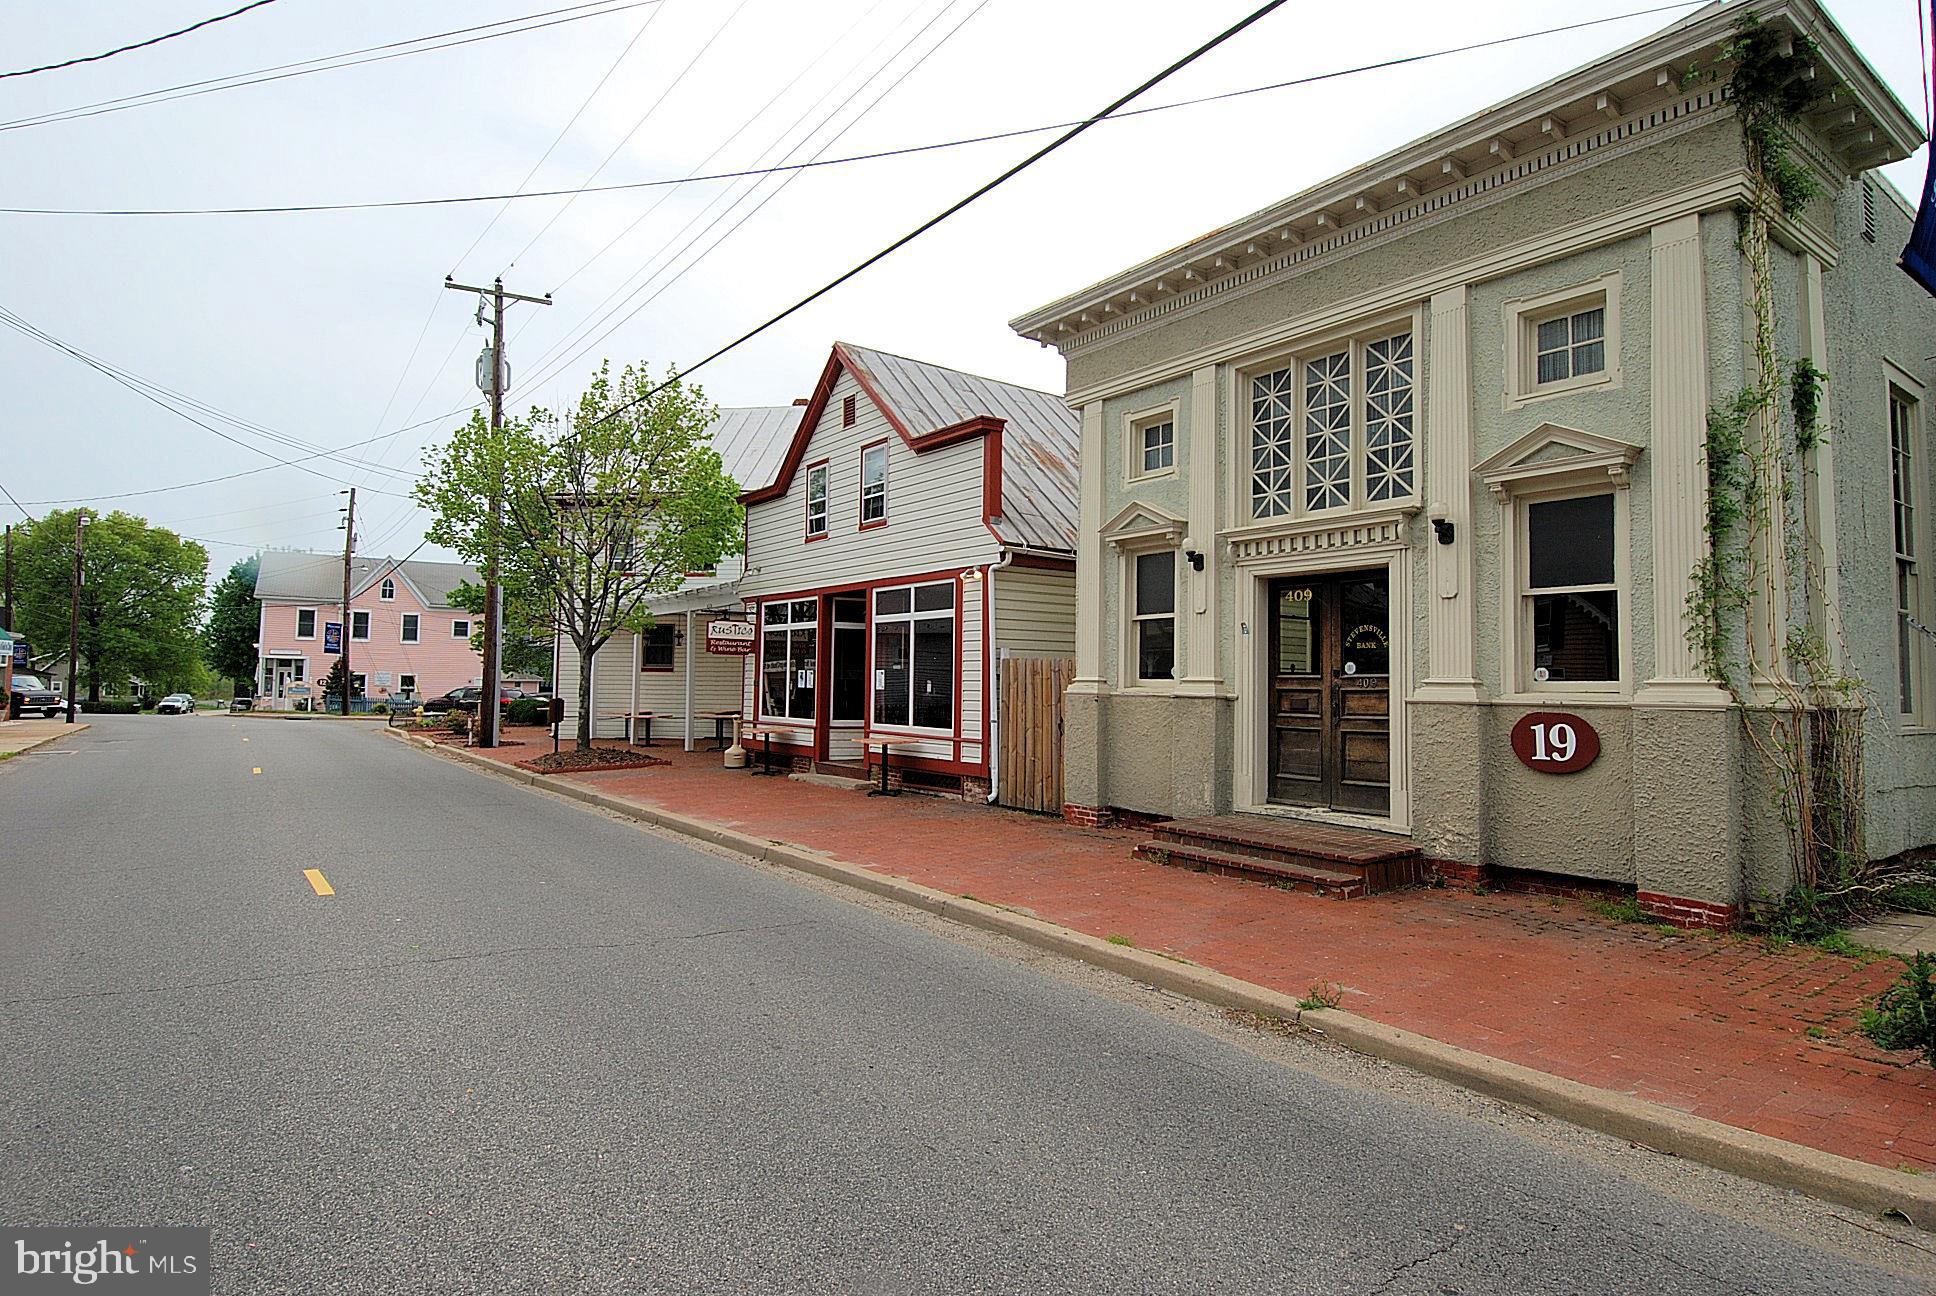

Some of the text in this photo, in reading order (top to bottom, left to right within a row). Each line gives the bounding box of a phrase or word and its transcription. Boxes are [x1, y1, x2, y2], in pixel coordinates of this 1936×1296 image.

[1285, 588, 1313, 602] 409
[1345, 624, 1389, 648] STEVENSVILLE
[1356, 678, 1377, 688] 409
[1530, 723, 1577, 762] 19
